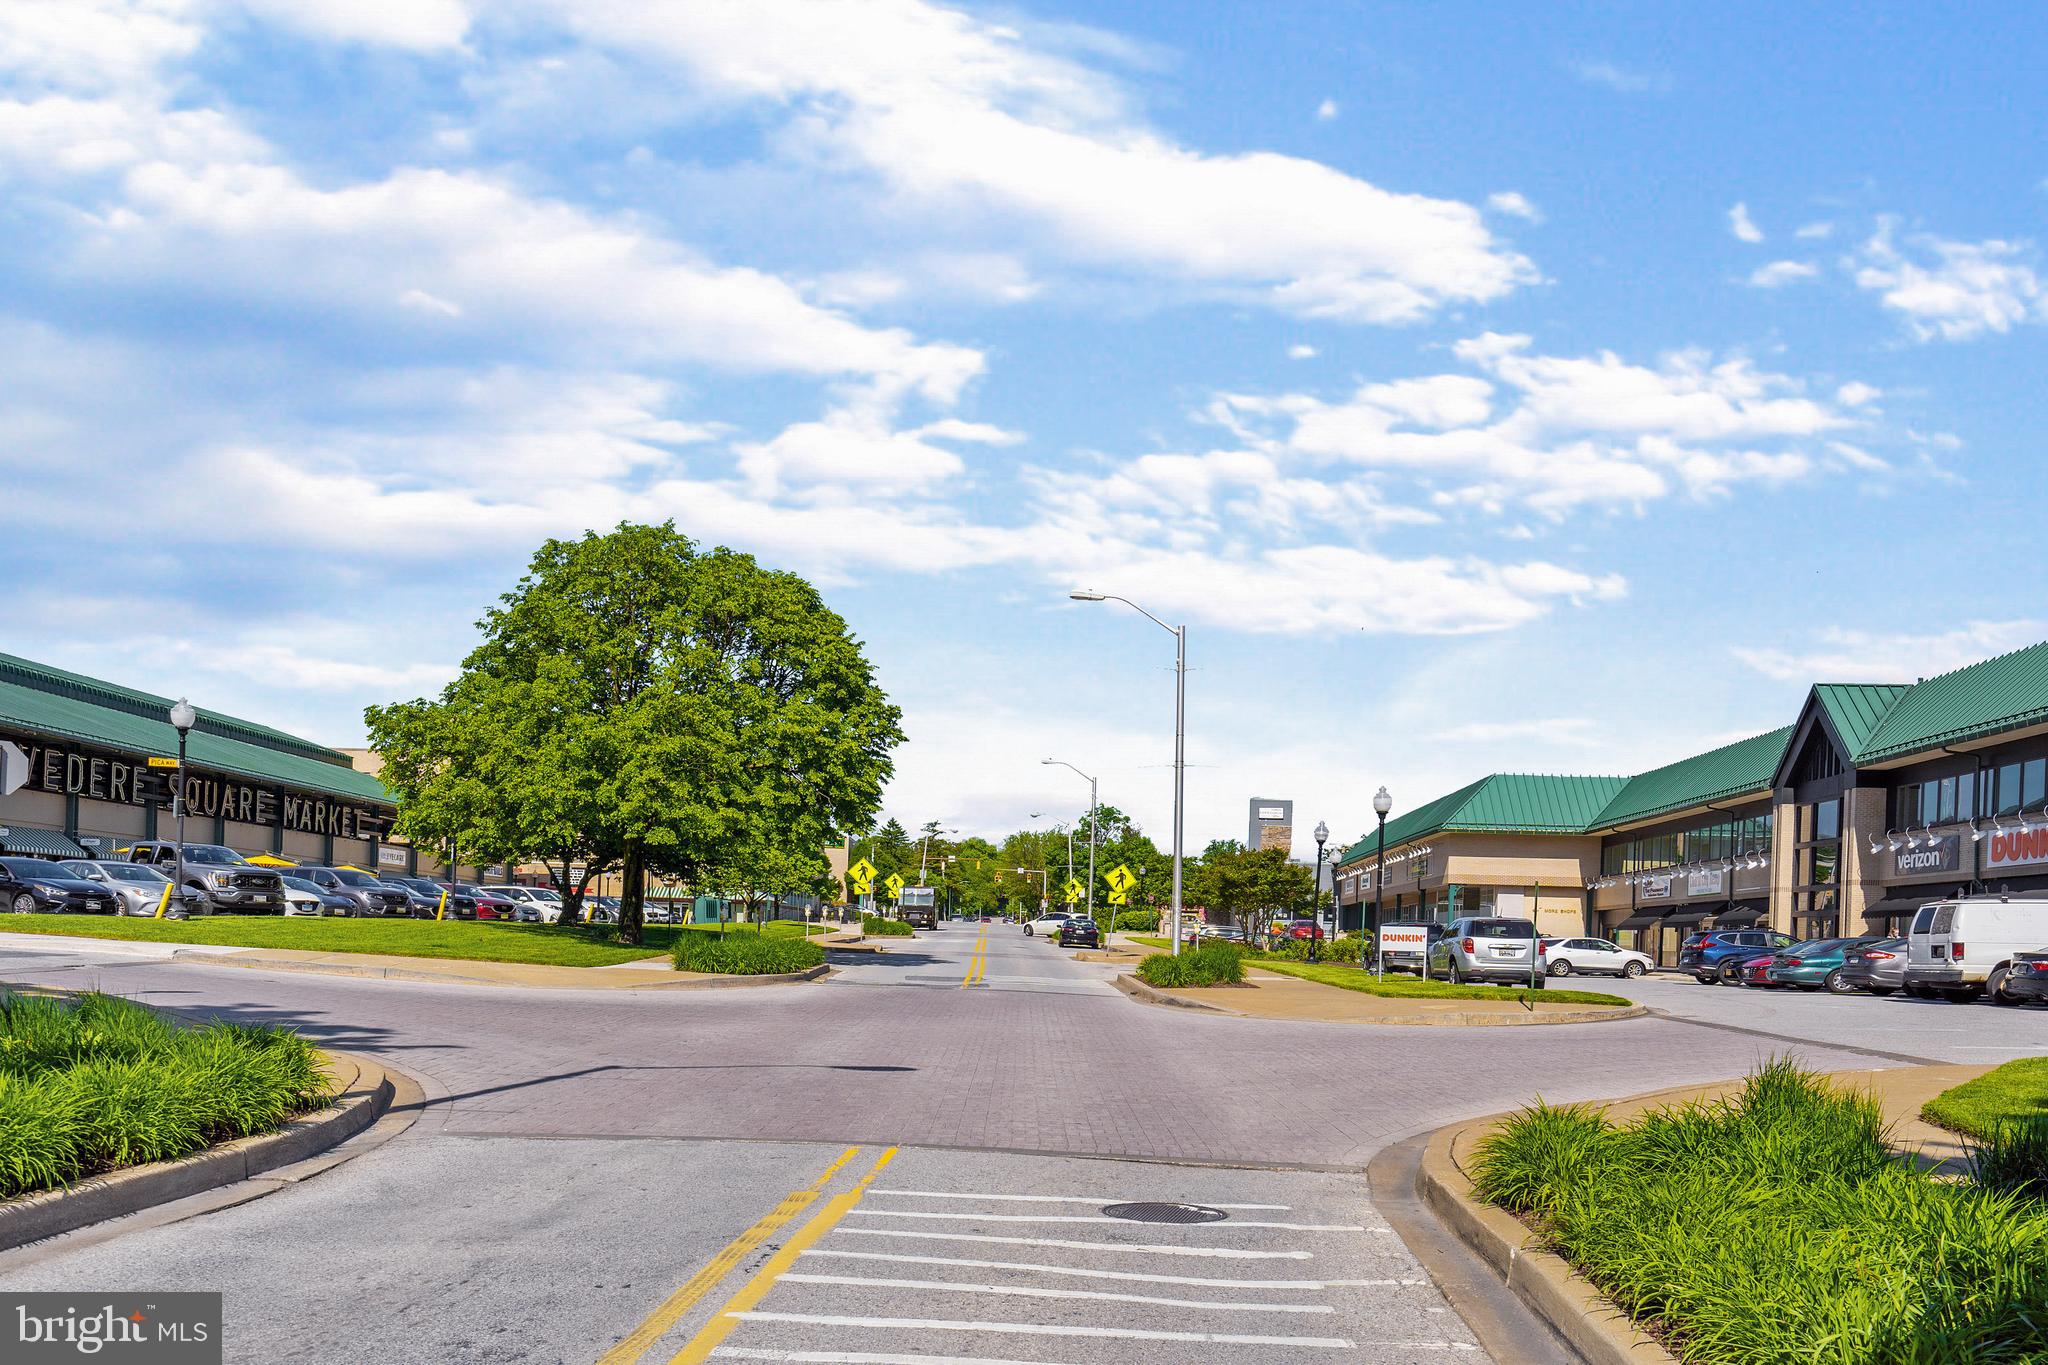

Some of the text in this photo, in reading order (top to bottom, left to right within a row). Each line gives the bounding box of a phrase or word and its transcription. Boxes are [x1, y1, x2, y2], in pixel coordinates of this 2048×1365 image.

[151, 758, 165, 766] PICA
[284, 794, 364, 838] MARKET
[1897, 849, 1940, 869] verizon
[1382, 933, 1426, 942] DUNKIN'
